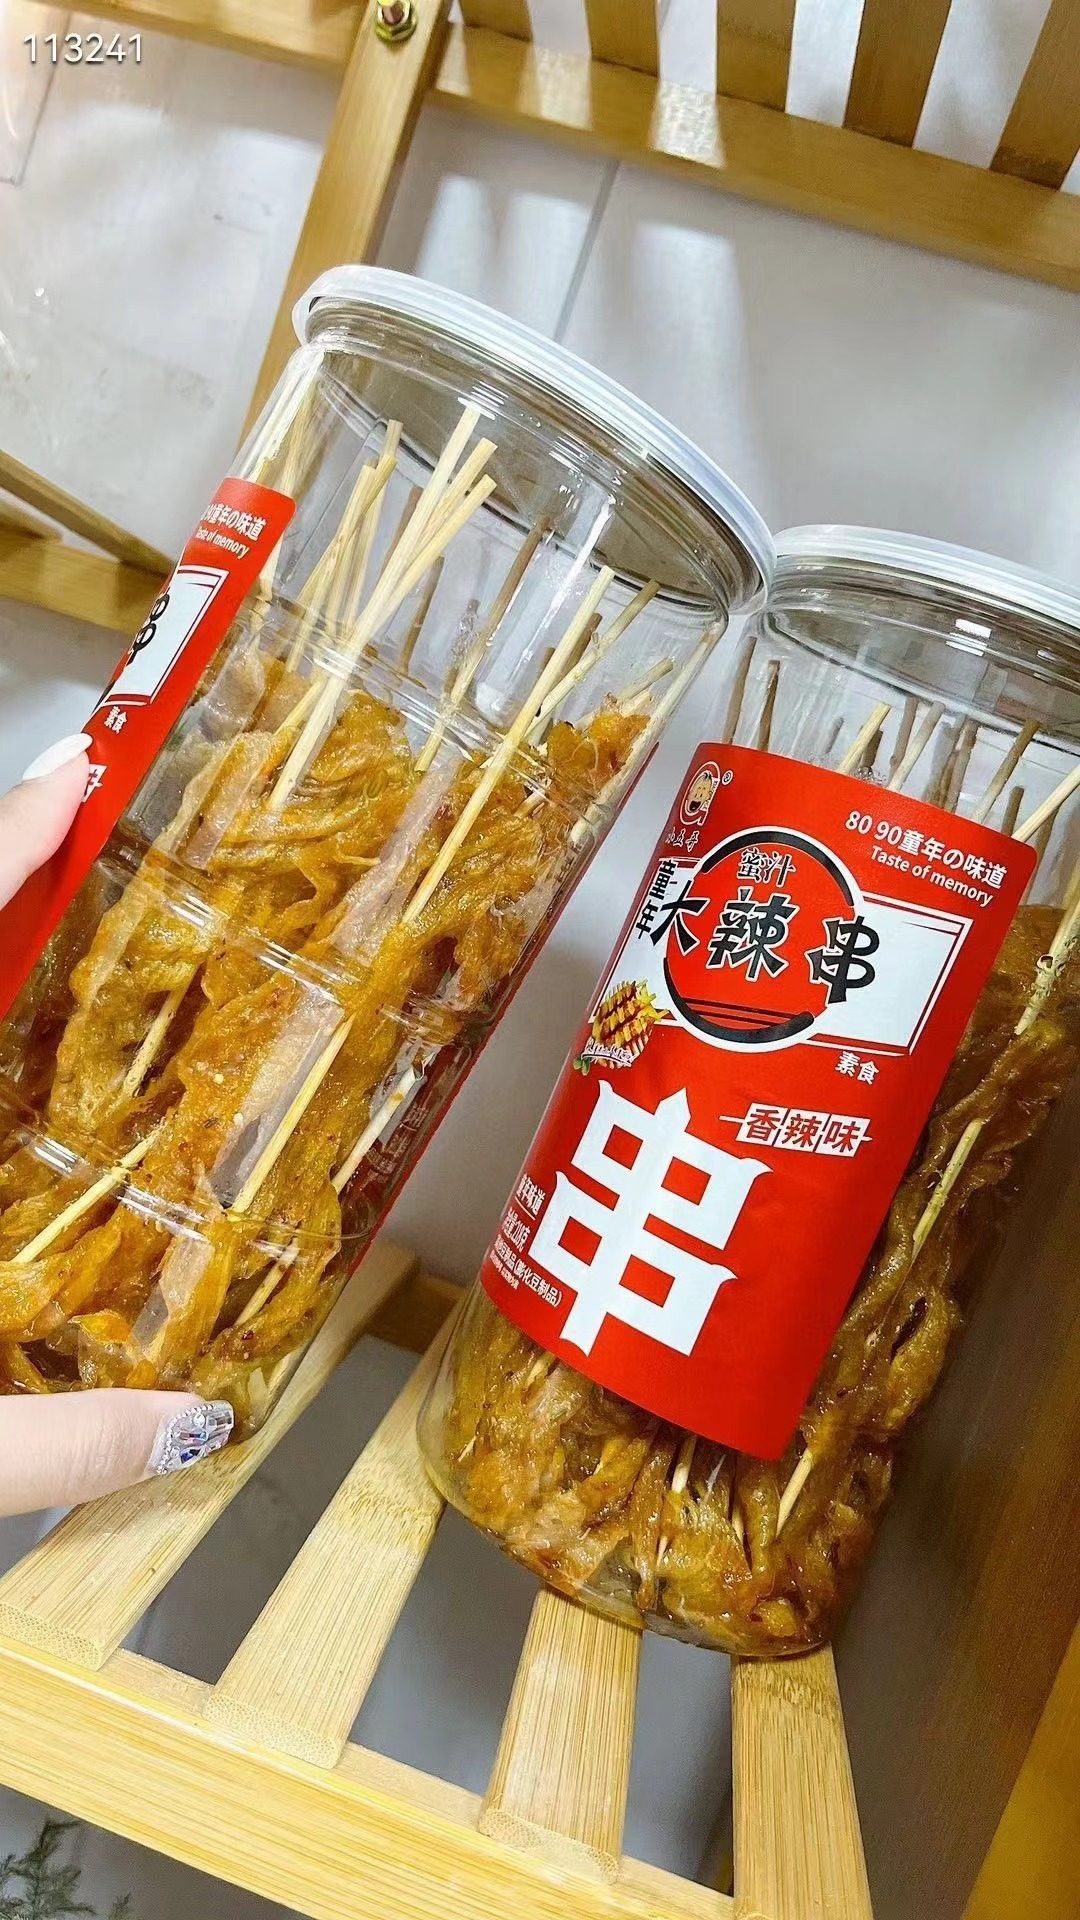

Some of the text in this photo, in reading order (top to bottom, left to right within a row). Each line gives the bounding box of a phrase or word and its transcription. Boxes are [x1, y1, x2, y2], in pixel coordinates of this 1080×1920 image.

[212, 534, 251, 560] memory
[103, 705, 128, 735] 素食
[845, 810, 873, 835] 80
[736, 847, 797, 888] 蜜汁
[871, 844, 994, 909] Taste of memory
[649, 879, 880, 1005] 大辣串
[834, 1050, 880, 1085] 素食
[745, 1107, 862, 1153] 香辣味
[527, 1079, 775, 1358] 串
